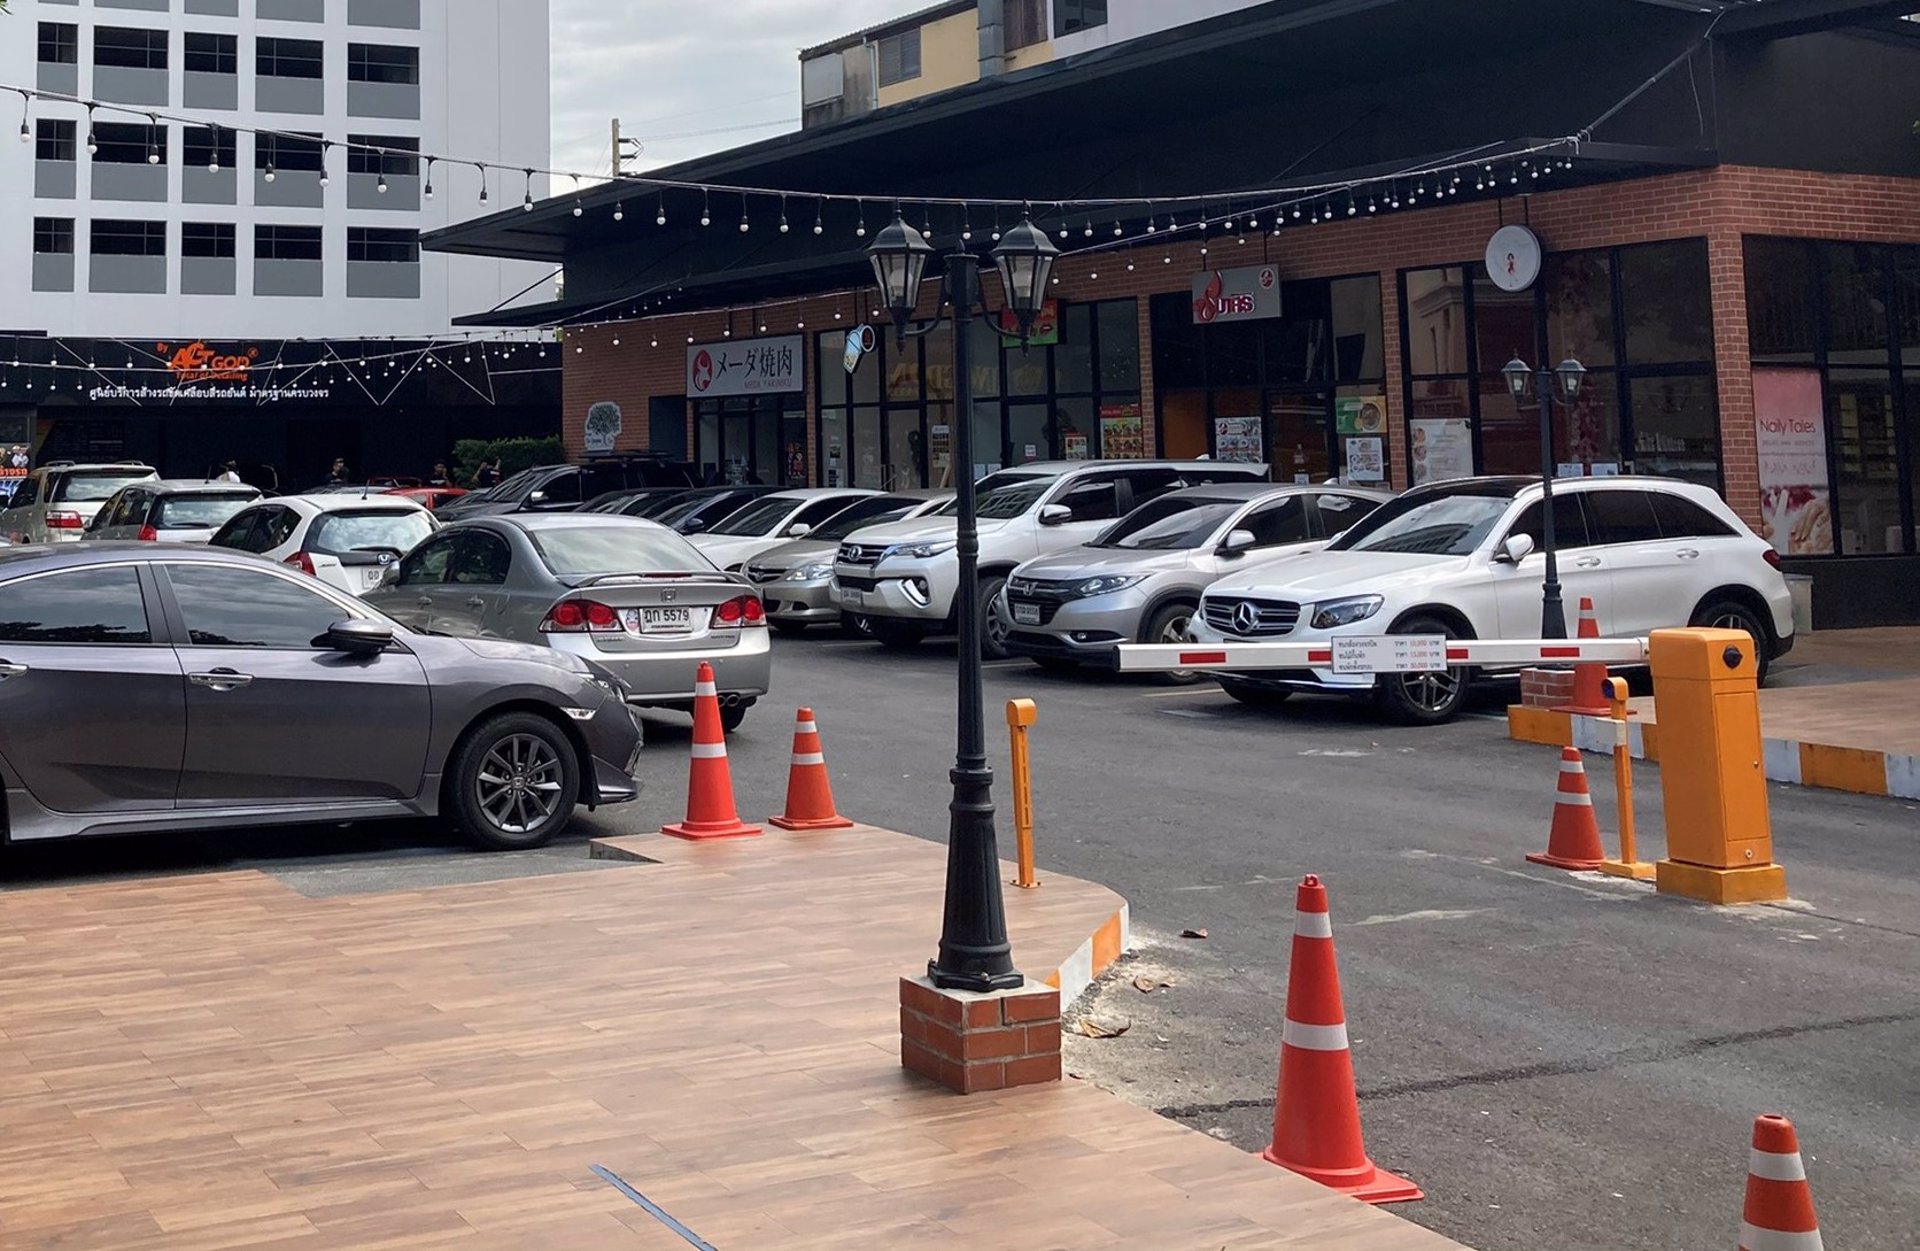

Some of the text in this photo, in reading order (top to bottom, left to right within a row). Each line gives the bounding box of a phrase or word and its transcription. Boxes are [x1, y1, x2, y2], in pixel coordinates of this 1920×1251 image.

[716, 345, 793, 379] メーダ焼肉
[1788, 418, 1816, 433] Tales
[663, 609, 689, 622] 5579
